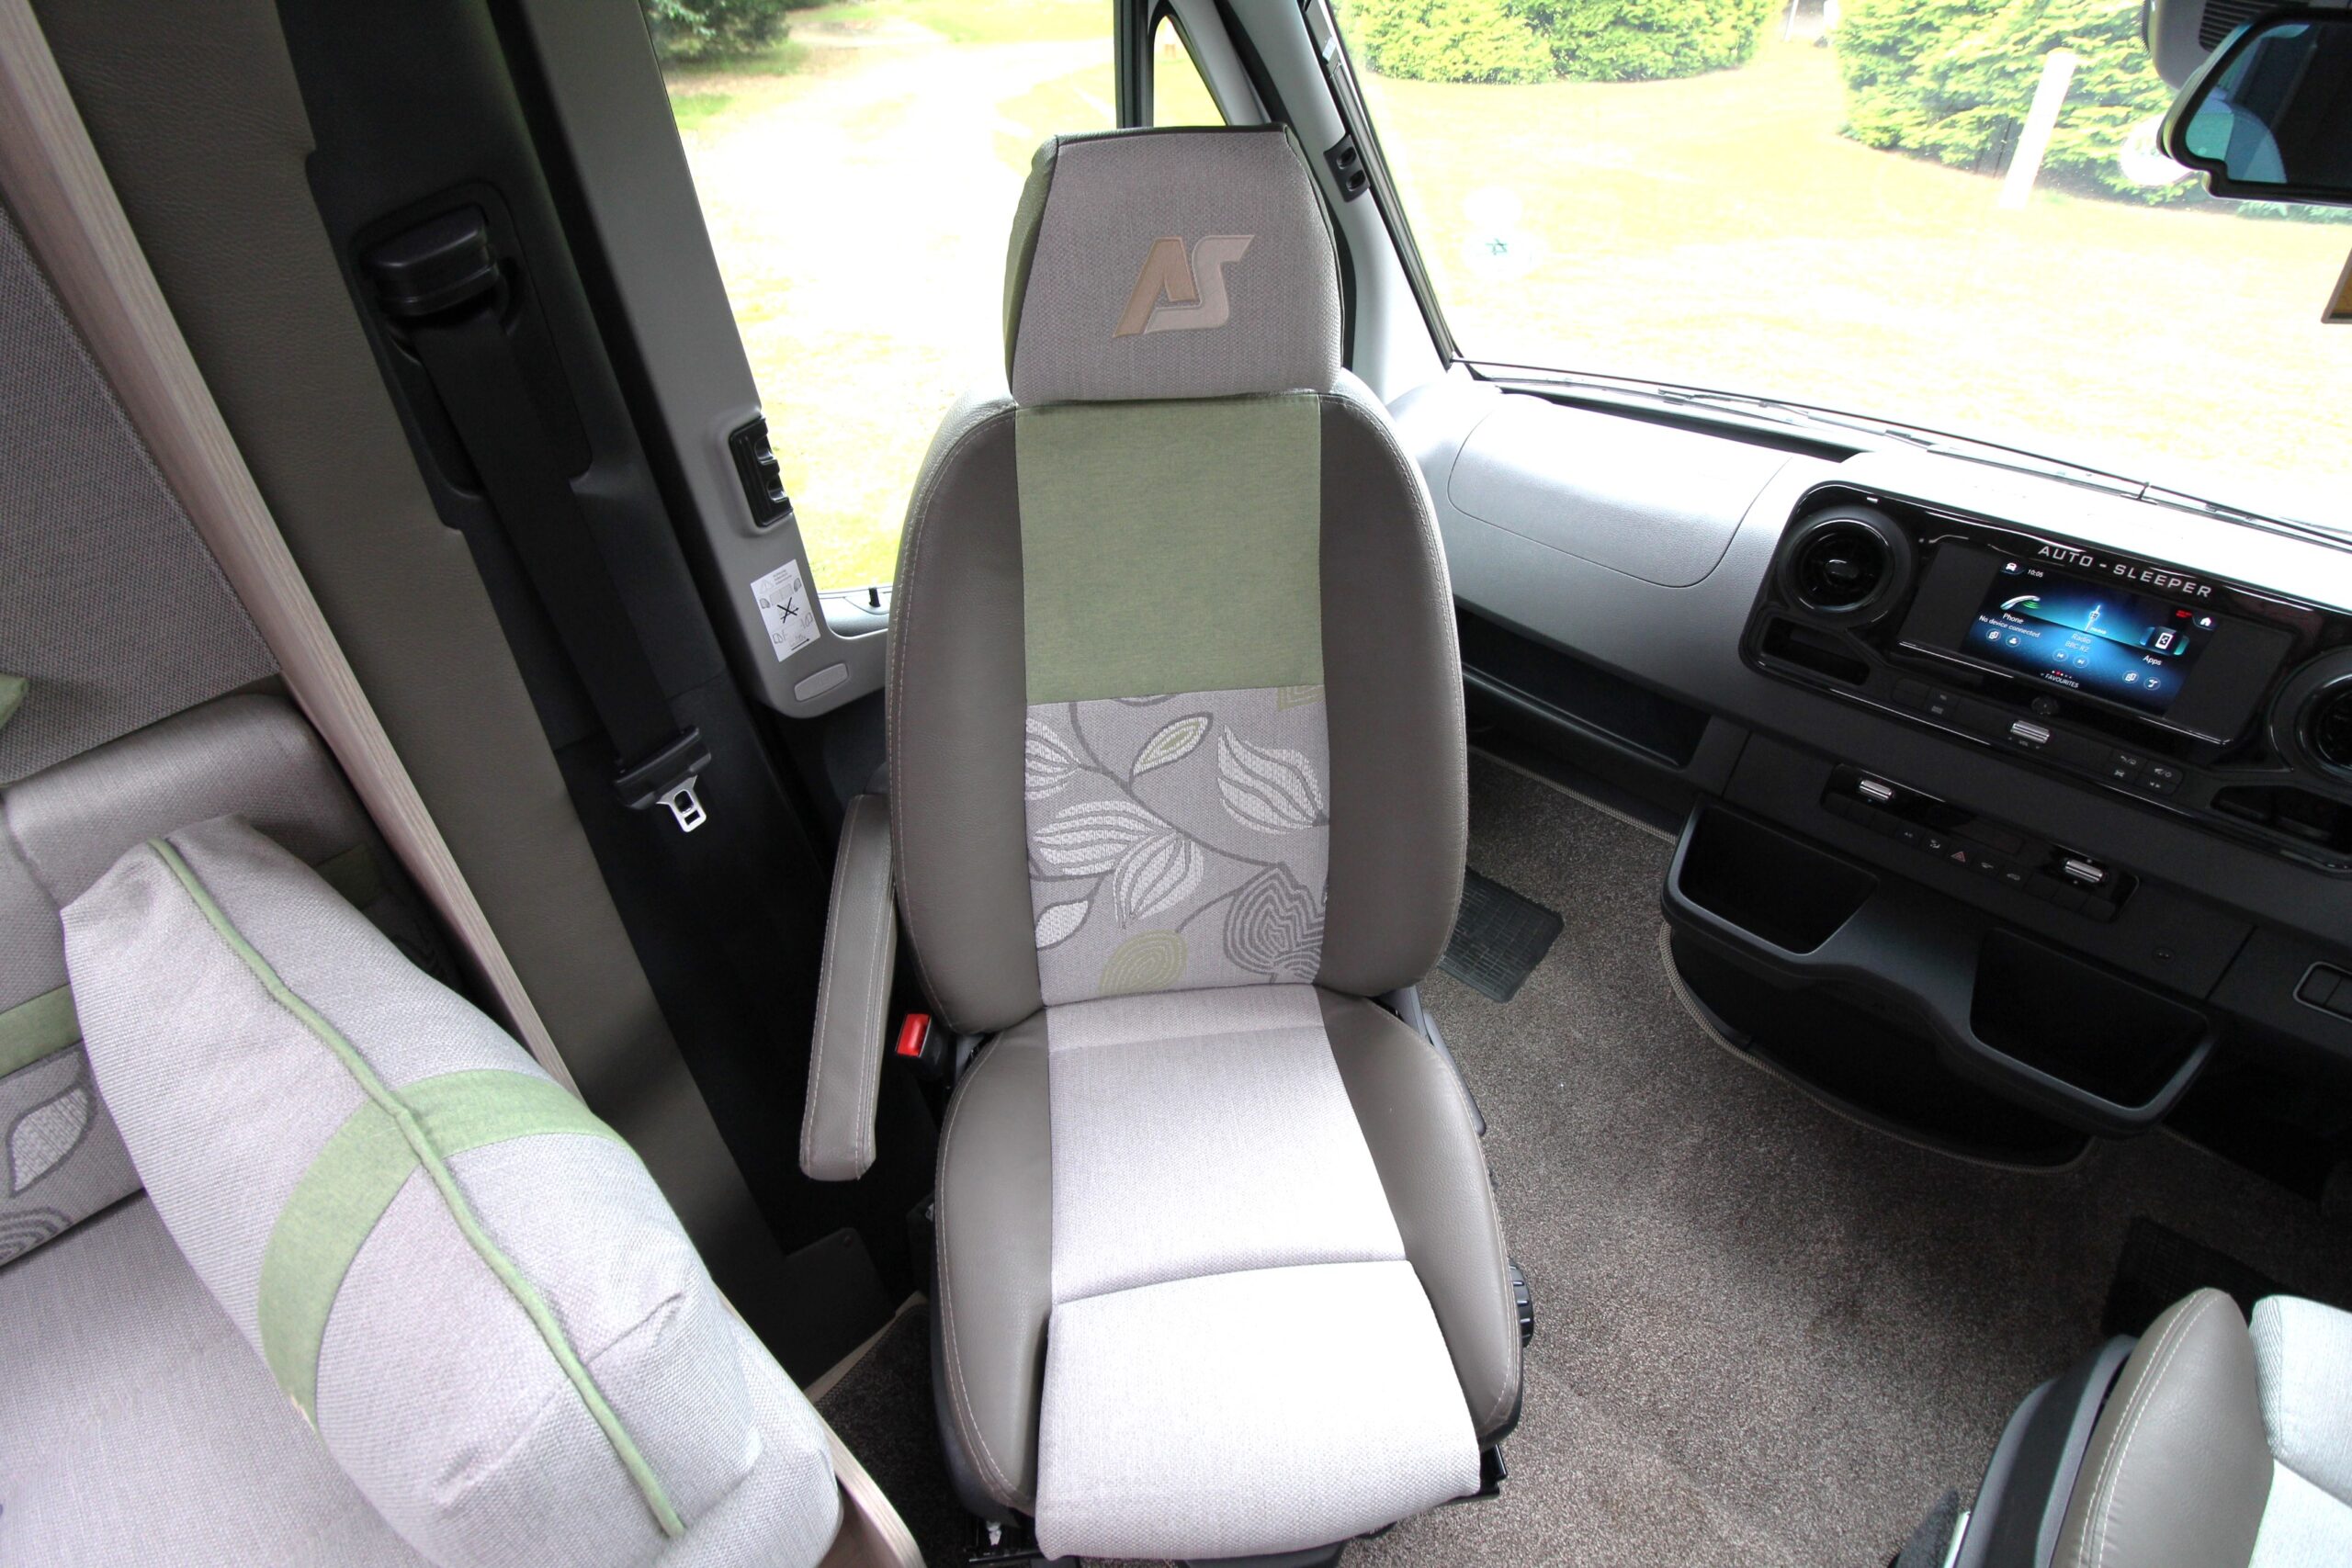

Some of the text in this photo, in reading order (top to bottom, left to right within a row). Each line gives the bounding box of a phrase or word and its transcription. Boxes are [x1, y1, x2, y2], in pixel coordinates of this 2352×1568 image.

[1112, 234, 1255, 338] AS
[2027, 569, 2044, 578] 10:05
[2038, 546, 2094, 568] AUTO
[2112, 563, 2212, 598] SLEEPER
[2003, 613, 2024, 625] Phone
[1978, 615, 2041, 637] No device connected
[2072, 633, 2092, 644] Radio
[2143, 655, 2162, 666] Apps
[2044, 673, 2079, 688] FAVOURITES
